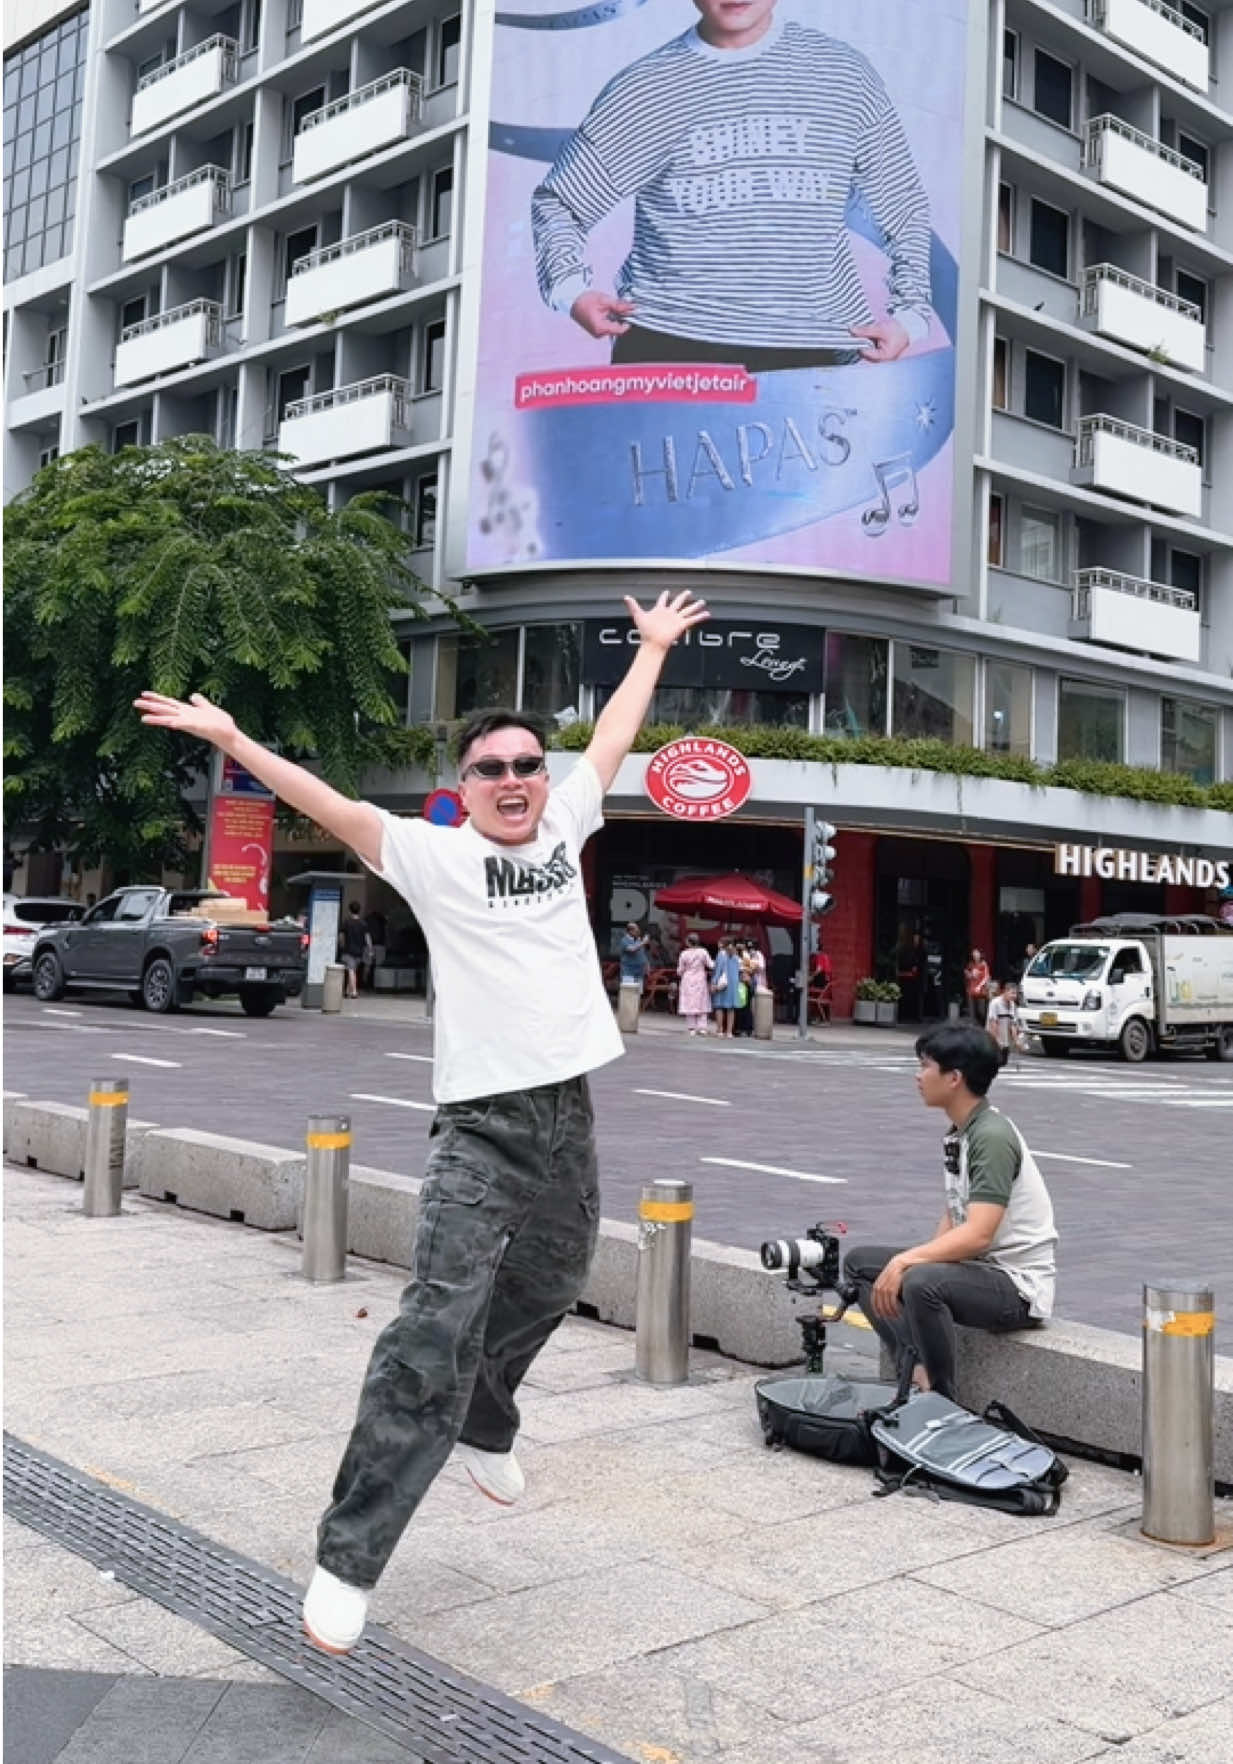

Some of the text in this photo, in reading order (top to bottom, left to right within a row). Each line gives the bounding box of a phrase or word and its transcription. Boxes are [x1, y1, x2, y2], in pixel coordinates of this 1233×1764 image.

[520, 373, 748, 402] phanhoangmyvietjetair
[630, 411, 853, 506] HAPAS
[652, 742, 746, 775] HIGHLANDS
[663, 796, 735, 816] COFFEE
[1055, 843, 1229, 889] HIGHLANDS
